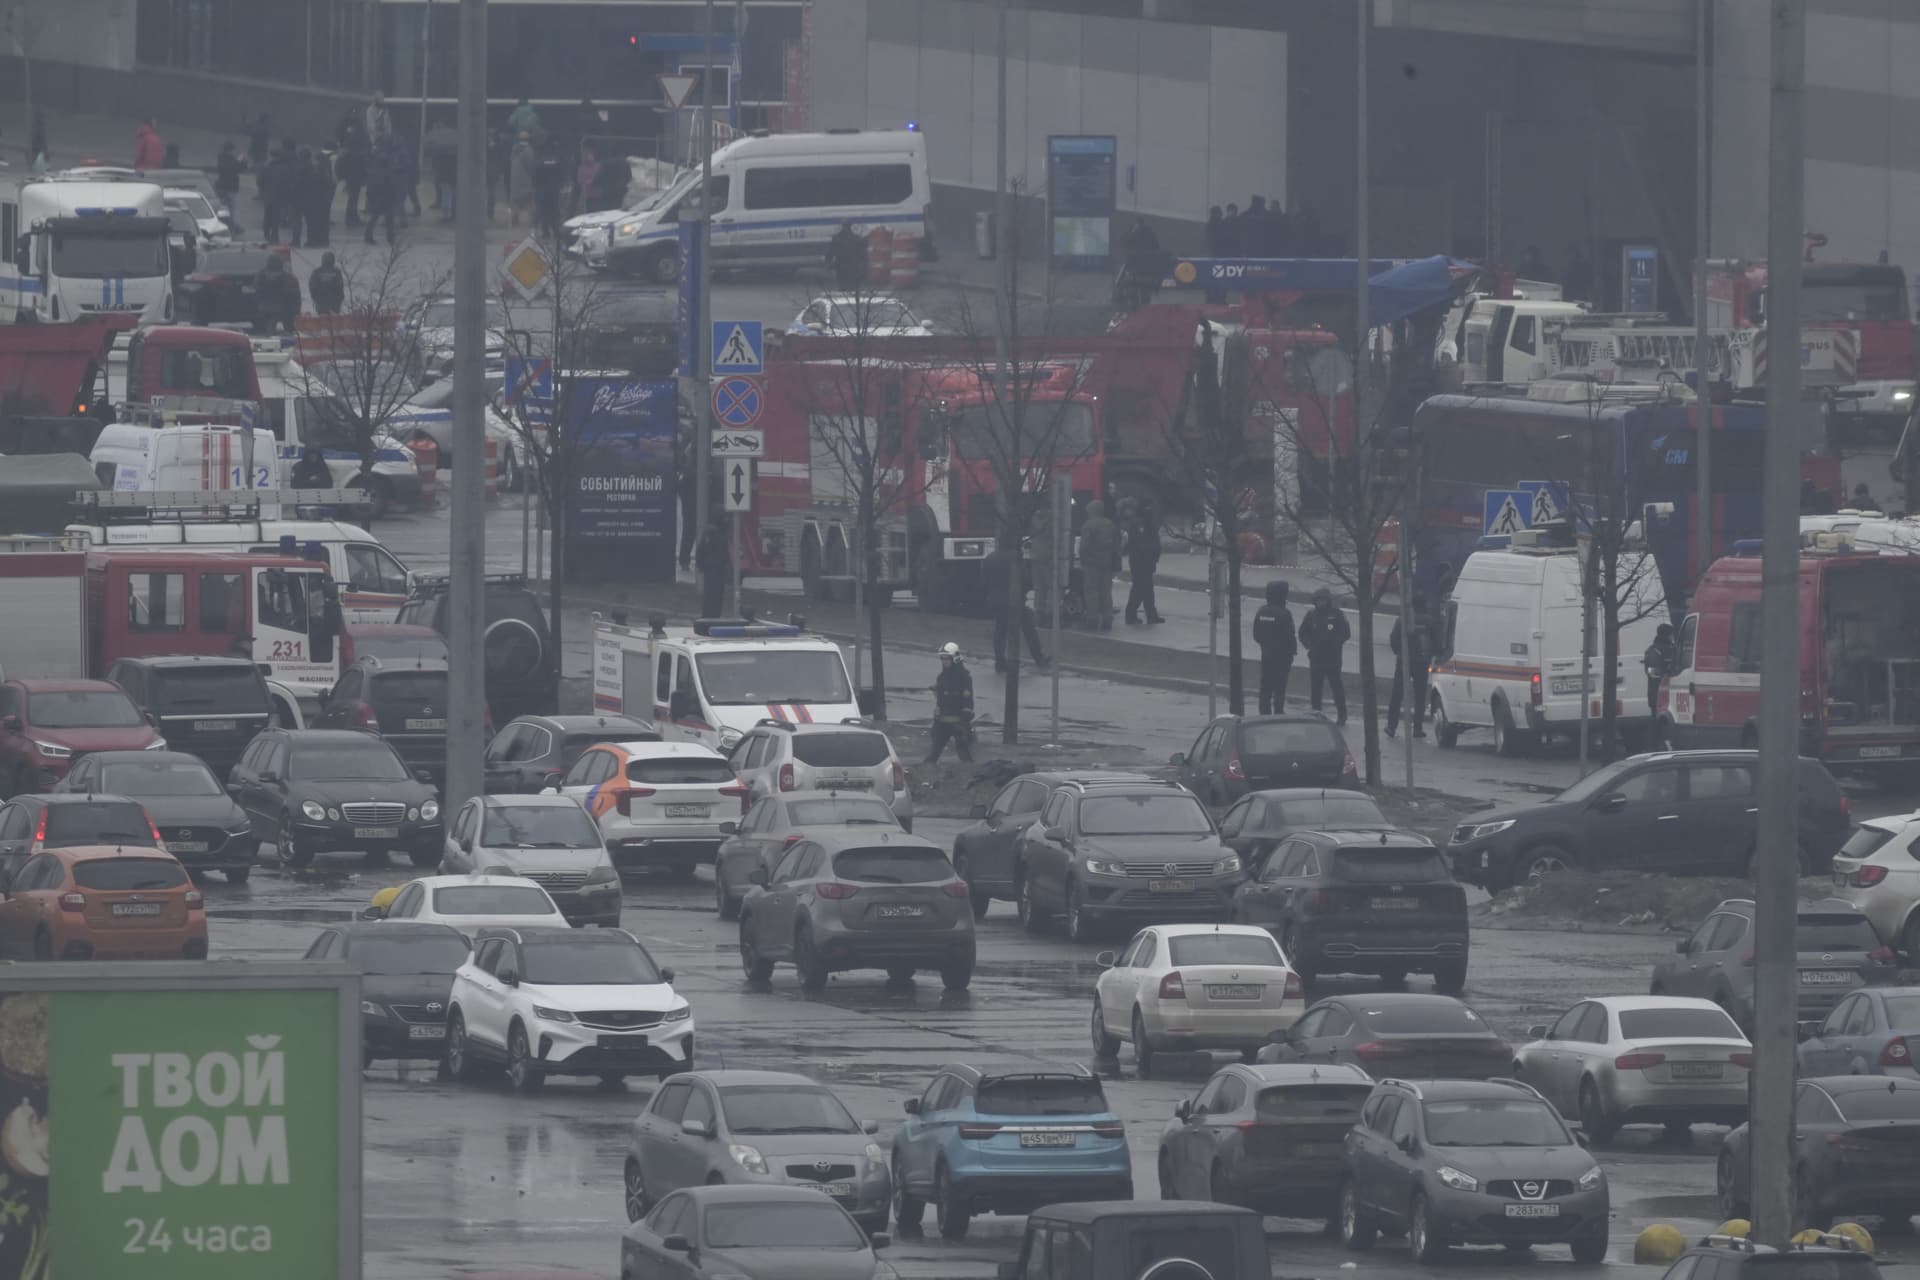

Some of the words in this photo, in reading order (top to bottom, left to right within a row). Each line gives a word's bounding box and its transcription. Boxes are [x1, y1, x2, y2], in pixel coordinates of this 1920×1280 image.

[1226, 265, 1245, 277] DY
[581, 475, 662, 491] СОБЫТИЙНЫЙ
[606, 494, 636, 502] РЕСТОРАН
[273, 640, 302, 656] 231
[111, 1034, 285, 1108] ТВОЙ
[103, 1115, 289, 1192] ДОМ
[122, 1217, 172, 1252] 24
[182, 1224, 271, 1252] часа
